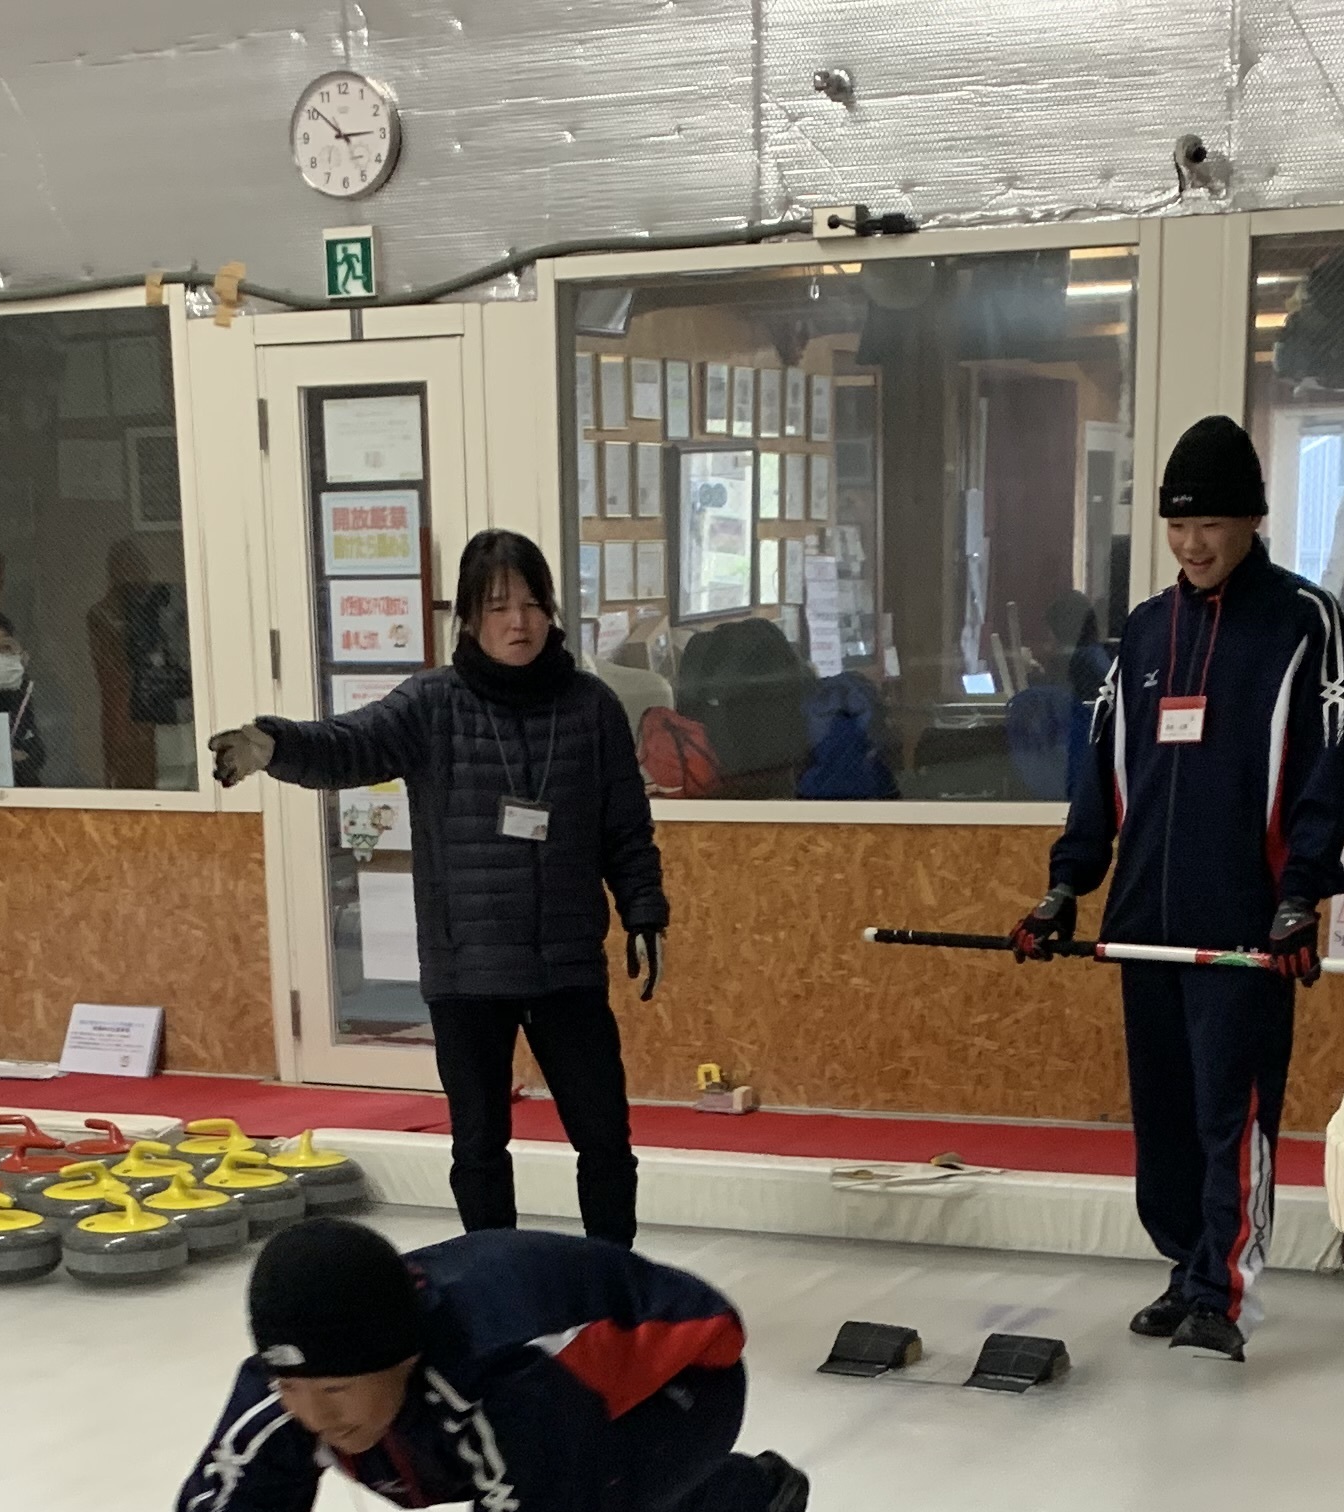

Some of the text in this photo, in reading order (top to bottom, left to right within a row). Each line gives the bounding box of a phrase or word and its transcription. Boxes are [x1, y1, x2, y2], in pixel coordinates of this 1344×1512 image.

[337, 82, 350, 95] 12
[320, 91, 330, 103] 11
[307, 108, 319, 121] 10
[372, 104, 380, 117] 2
[303, 132, 310, 145] 9
[379, 127, 386, 139] 3
[310, 156, 317, 168] 8
[374, 152, 382, 164] 4
[324, 172, 331, 184] 7
[360, 170, 367, 182] 5
[342, 176, 350, 189] 6
